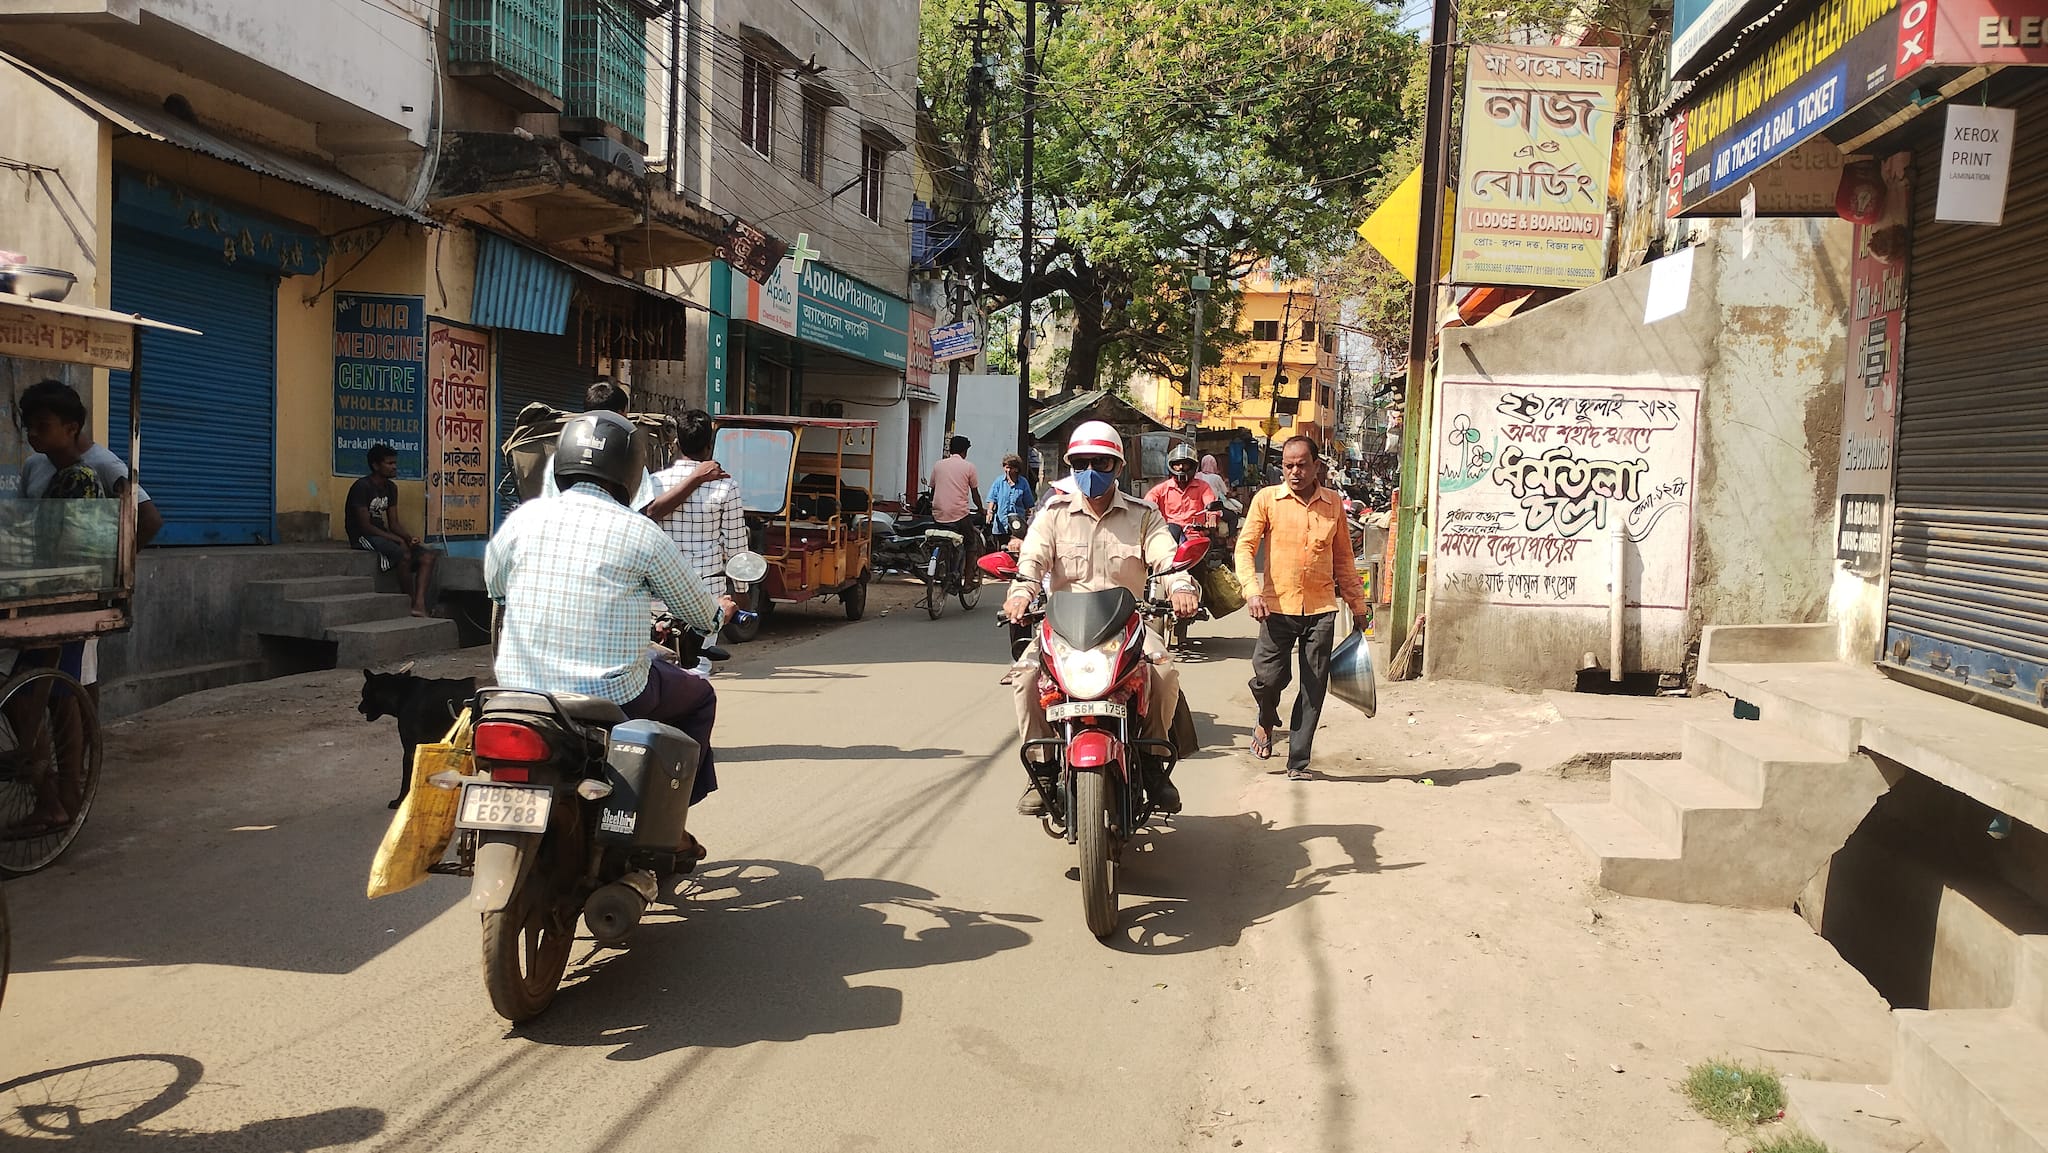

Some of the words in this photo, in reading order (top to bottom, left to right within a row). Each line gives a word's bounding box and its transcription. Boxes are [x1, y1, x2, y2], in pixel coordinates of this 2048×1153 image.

[1484, 53, 1511, 75] মা
[1686, 106, 1698, 156] SA
[1697, 97, 1709, 149] RE
[1708, 91, 1720, 141] GA
[1720, 78, 1734, 133] MA
[1736, 54, 1763, 123] MUSIC
[1765, 23, 1805, 102] CORNER
[1806, 11, 1814, 73] &
[1815, 0, 1897, 65] ELECTRO
[1478, 86, 1602, 136] লজ
[1715, 149, 1731, 181] AIR
[1732, 126, 1763, 171] TICKET
[1763, 121, 1770, 152] &
[1772, 106, 1795, 146] RAIL
[1798, 75, 1838, 130] TICKET
[1953, 127, 1999, 143] XEROX
[1668, 109, 1685, 209] XEROX
[1952, 151, 1992, 167] PRINT
[1471, 161, 1594, 203] বোর্ডিং
[1949, 172, 1990, 180] LAMINATION
[1519, 214, 1528, 231] &
[766, 281, 791, 305] Apollo
[360, 302, 409, 330] UMA
[336, 332, 423, 362] MEDICINE
[449, 337, 486, 375] মায়া
[910, 351, 932, 371] LODGE
[339, 362, 415, 393] CENTRE
[339, 395, 414, 413] WHOLESALE
[1639, 399, 1680, 422] ২০২২
[335, 416, 383, 432] MEDICINE
[385, 418, 419, 433] DEALER
[1501, 424, 1555, 443] অমর
[1556, 420, 1601, 448] শহীদ
[1845, 428, 1890, 471] Electronics
[1493, 445, 1649, 502] ধর্মতলা
[1441, 533, 1486, 558] মমতা
[1841, 531, 1859, 551] MUSIC
[1859, 531, 1881, 553] CORNER
[1543, 575, 1577, 599] কংগ্রেস
[1075, 704, 1094, 714] 56M
[480, 786, 537, 806] WB68A
[477, 804, 537, 824] E6788
[602, 807, 637, 831] Steelbird
